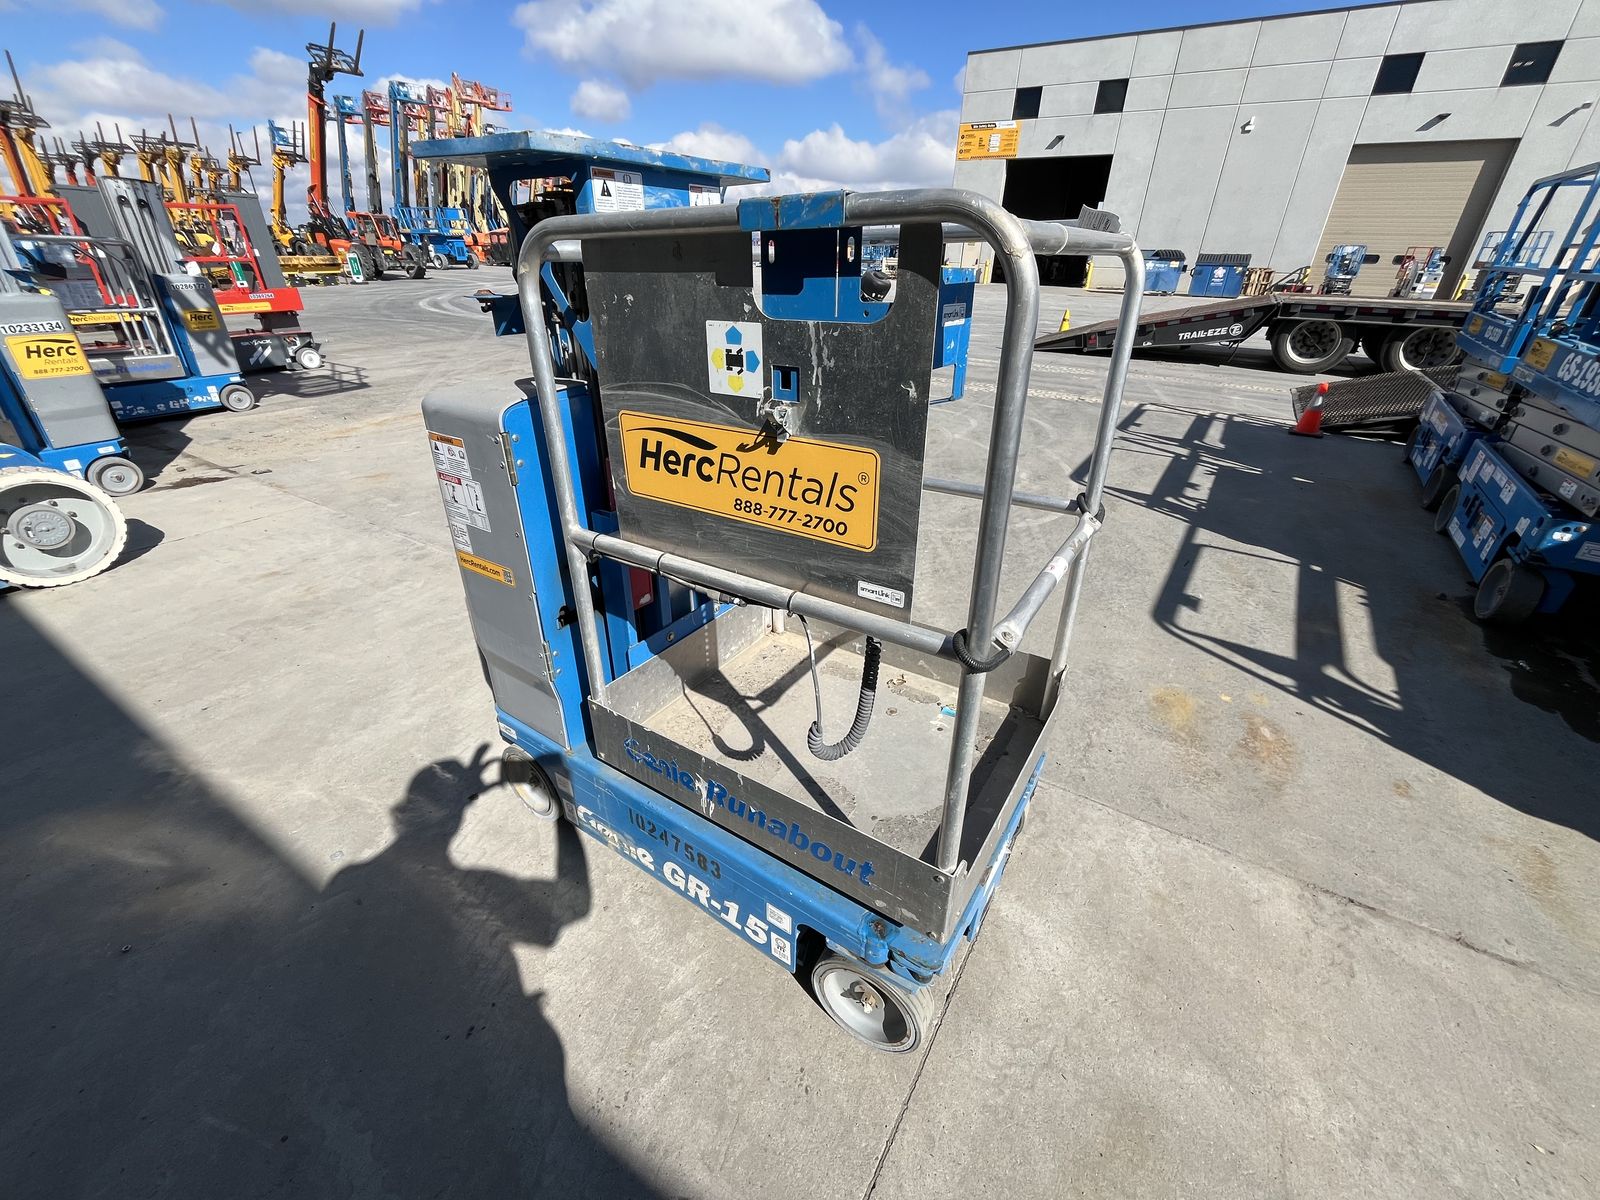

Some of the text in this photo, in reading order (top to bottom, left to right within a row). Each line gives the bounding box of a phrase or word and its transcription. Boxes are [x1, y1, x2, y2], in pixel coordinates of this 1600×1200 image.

[1, 321, 62, 334] 10233134
[1178, 327, 1228, 340] TRAIL-EZE
[25, 345, 77, 359] Herc
[44, 357, 79, 365] Rentals
[733, 498, 848, 536] 888-777-2700
[628, 807, 722, 880] 10247583
[707, 778, 875, 887] Runabout
[662, 861, 769, 945] GR-15
